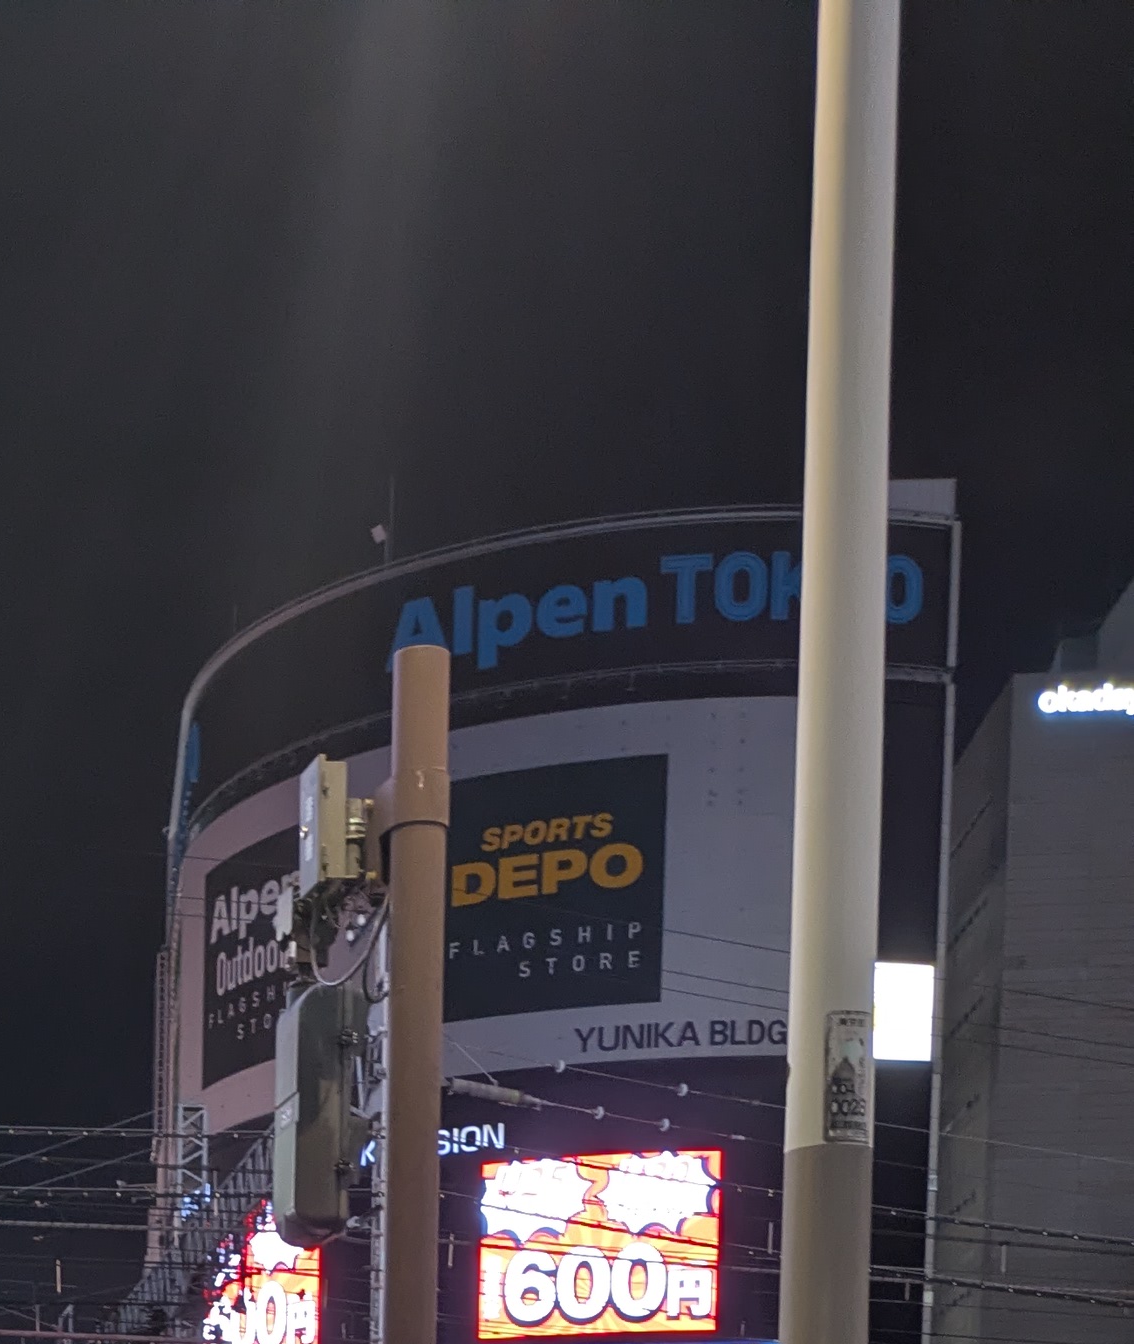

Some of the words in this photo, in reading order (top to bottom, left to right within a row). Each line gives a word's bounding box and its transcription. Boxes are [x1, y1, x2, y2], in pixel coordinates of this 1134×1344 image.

[386, 575, 648, 672] Alpen
[660, 551, 923, 624] TOKO
[480, 812, 615, 851] SPORTS
[450, 842, 644, 907] DEPO
[449, 921, 642, 960] FLAGSHIP
[519, 951, 640, 978] STORE
[574, 1021, 701, 1052] YUNIKA
